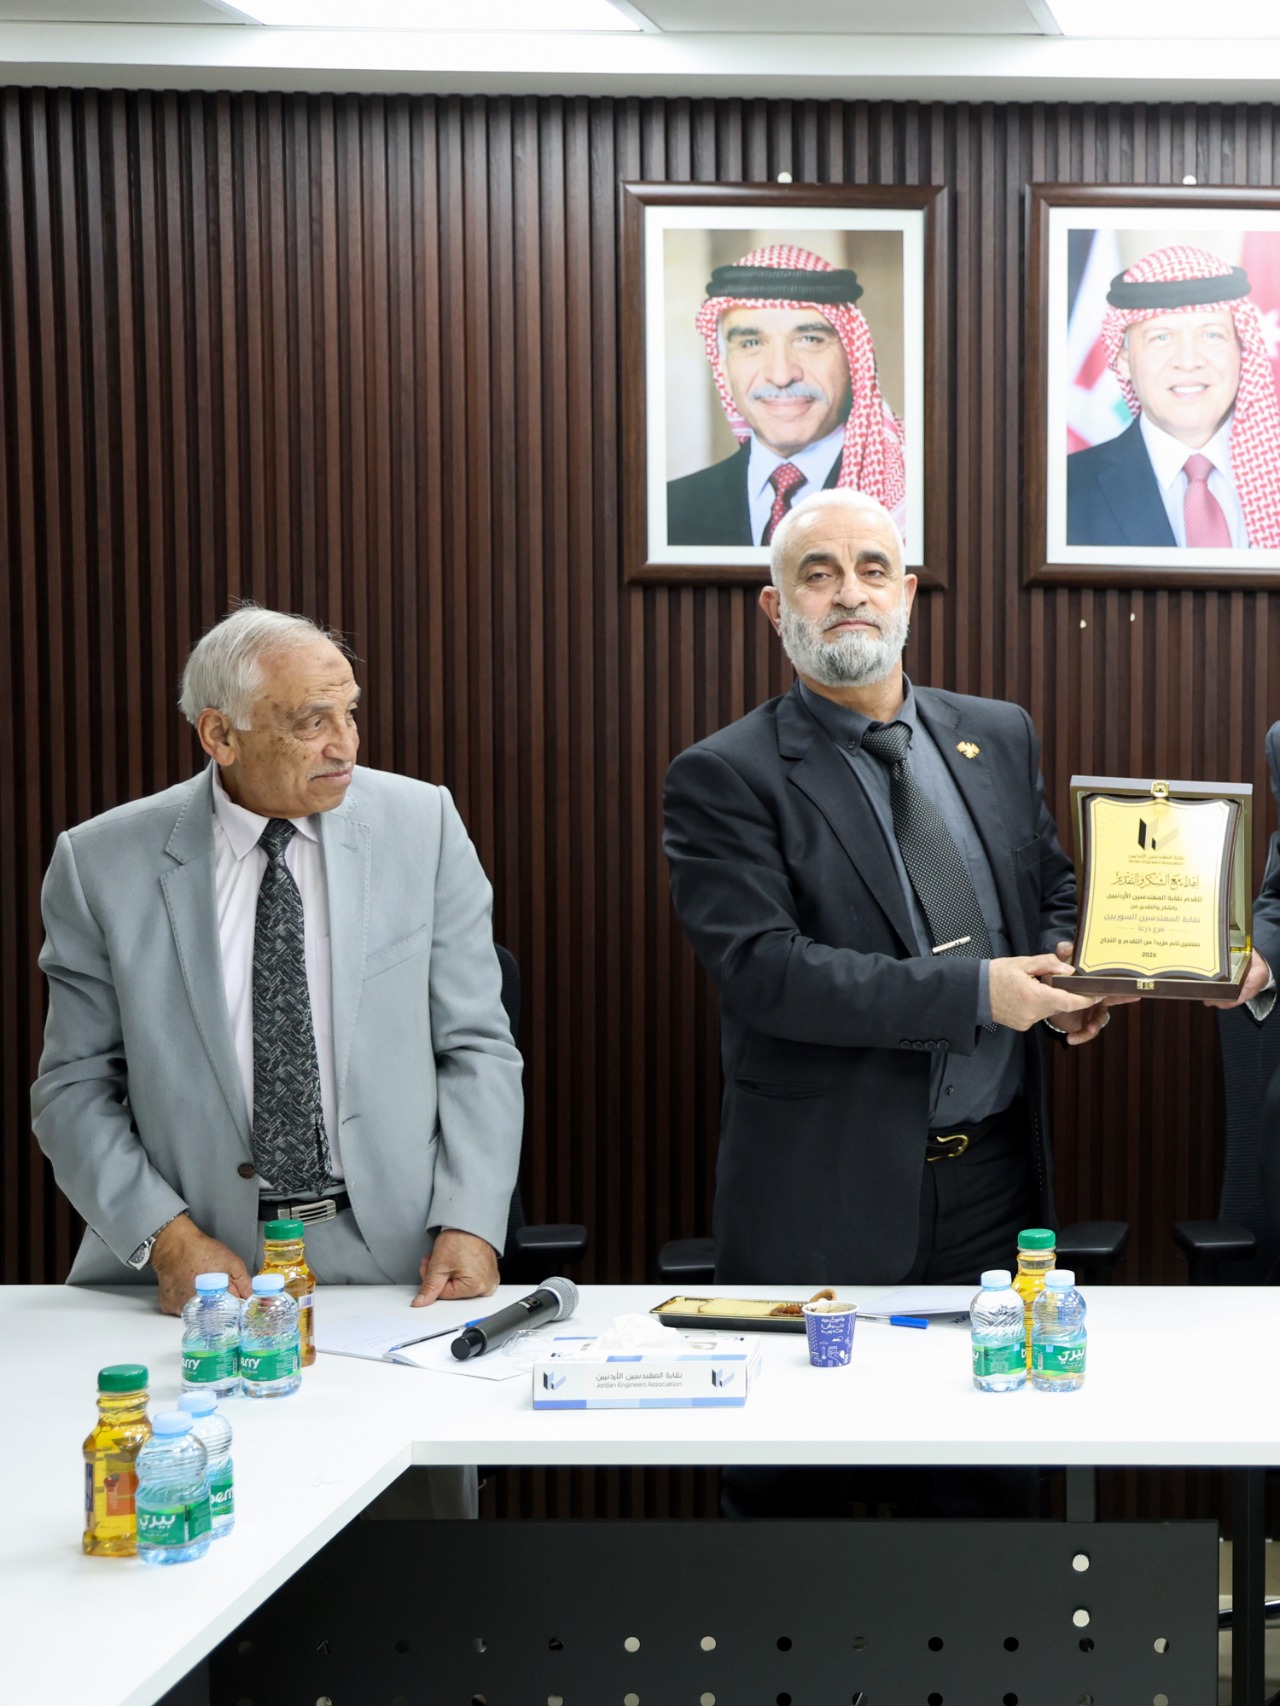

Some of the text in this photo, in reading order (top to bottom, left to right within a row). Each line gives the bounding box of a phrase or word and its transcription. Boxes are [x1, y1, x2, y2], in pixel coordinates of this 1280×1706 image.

[1132, 894, 1167, 902] المهندسين
[1103, 913, 1137, 921] السوريين
[1182, 915, 1201, 924] نقابة
[595, 1370, 683, 1381] نقابة المهندسين الأردنيين
[617, 1381, 647, 1389] Engineers
[648, 1380, 683, 1388] Association
[139, 1514, 176, 1531] بيري
